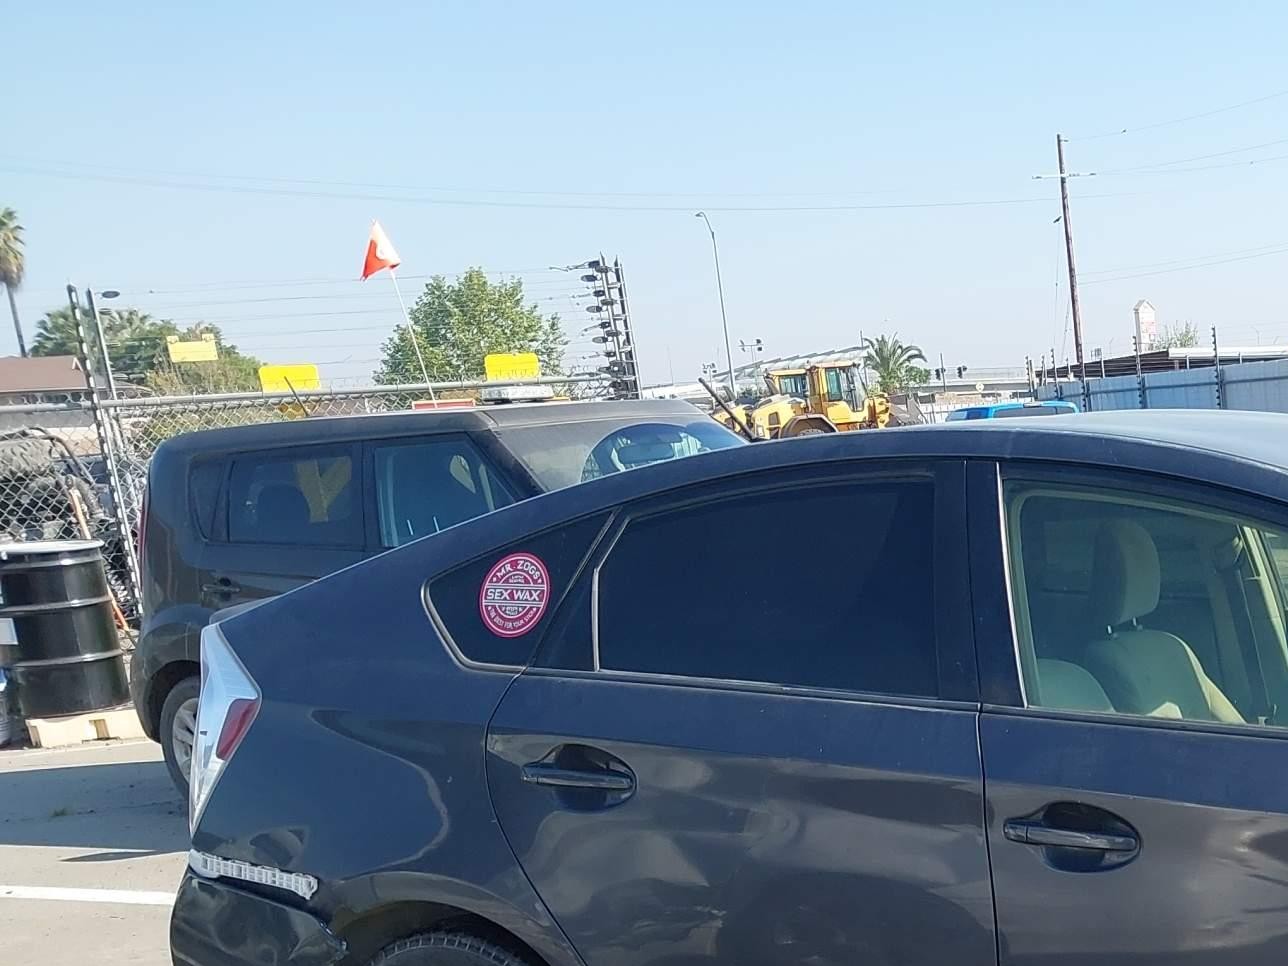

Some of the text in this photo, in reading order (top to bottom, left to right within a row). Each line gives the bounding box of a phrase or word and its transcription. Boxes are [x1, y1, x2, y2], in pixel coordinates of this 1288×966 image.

[517, 560, 540, 579] ZOGS
[486, 589, 540, 601] SEX WAX
